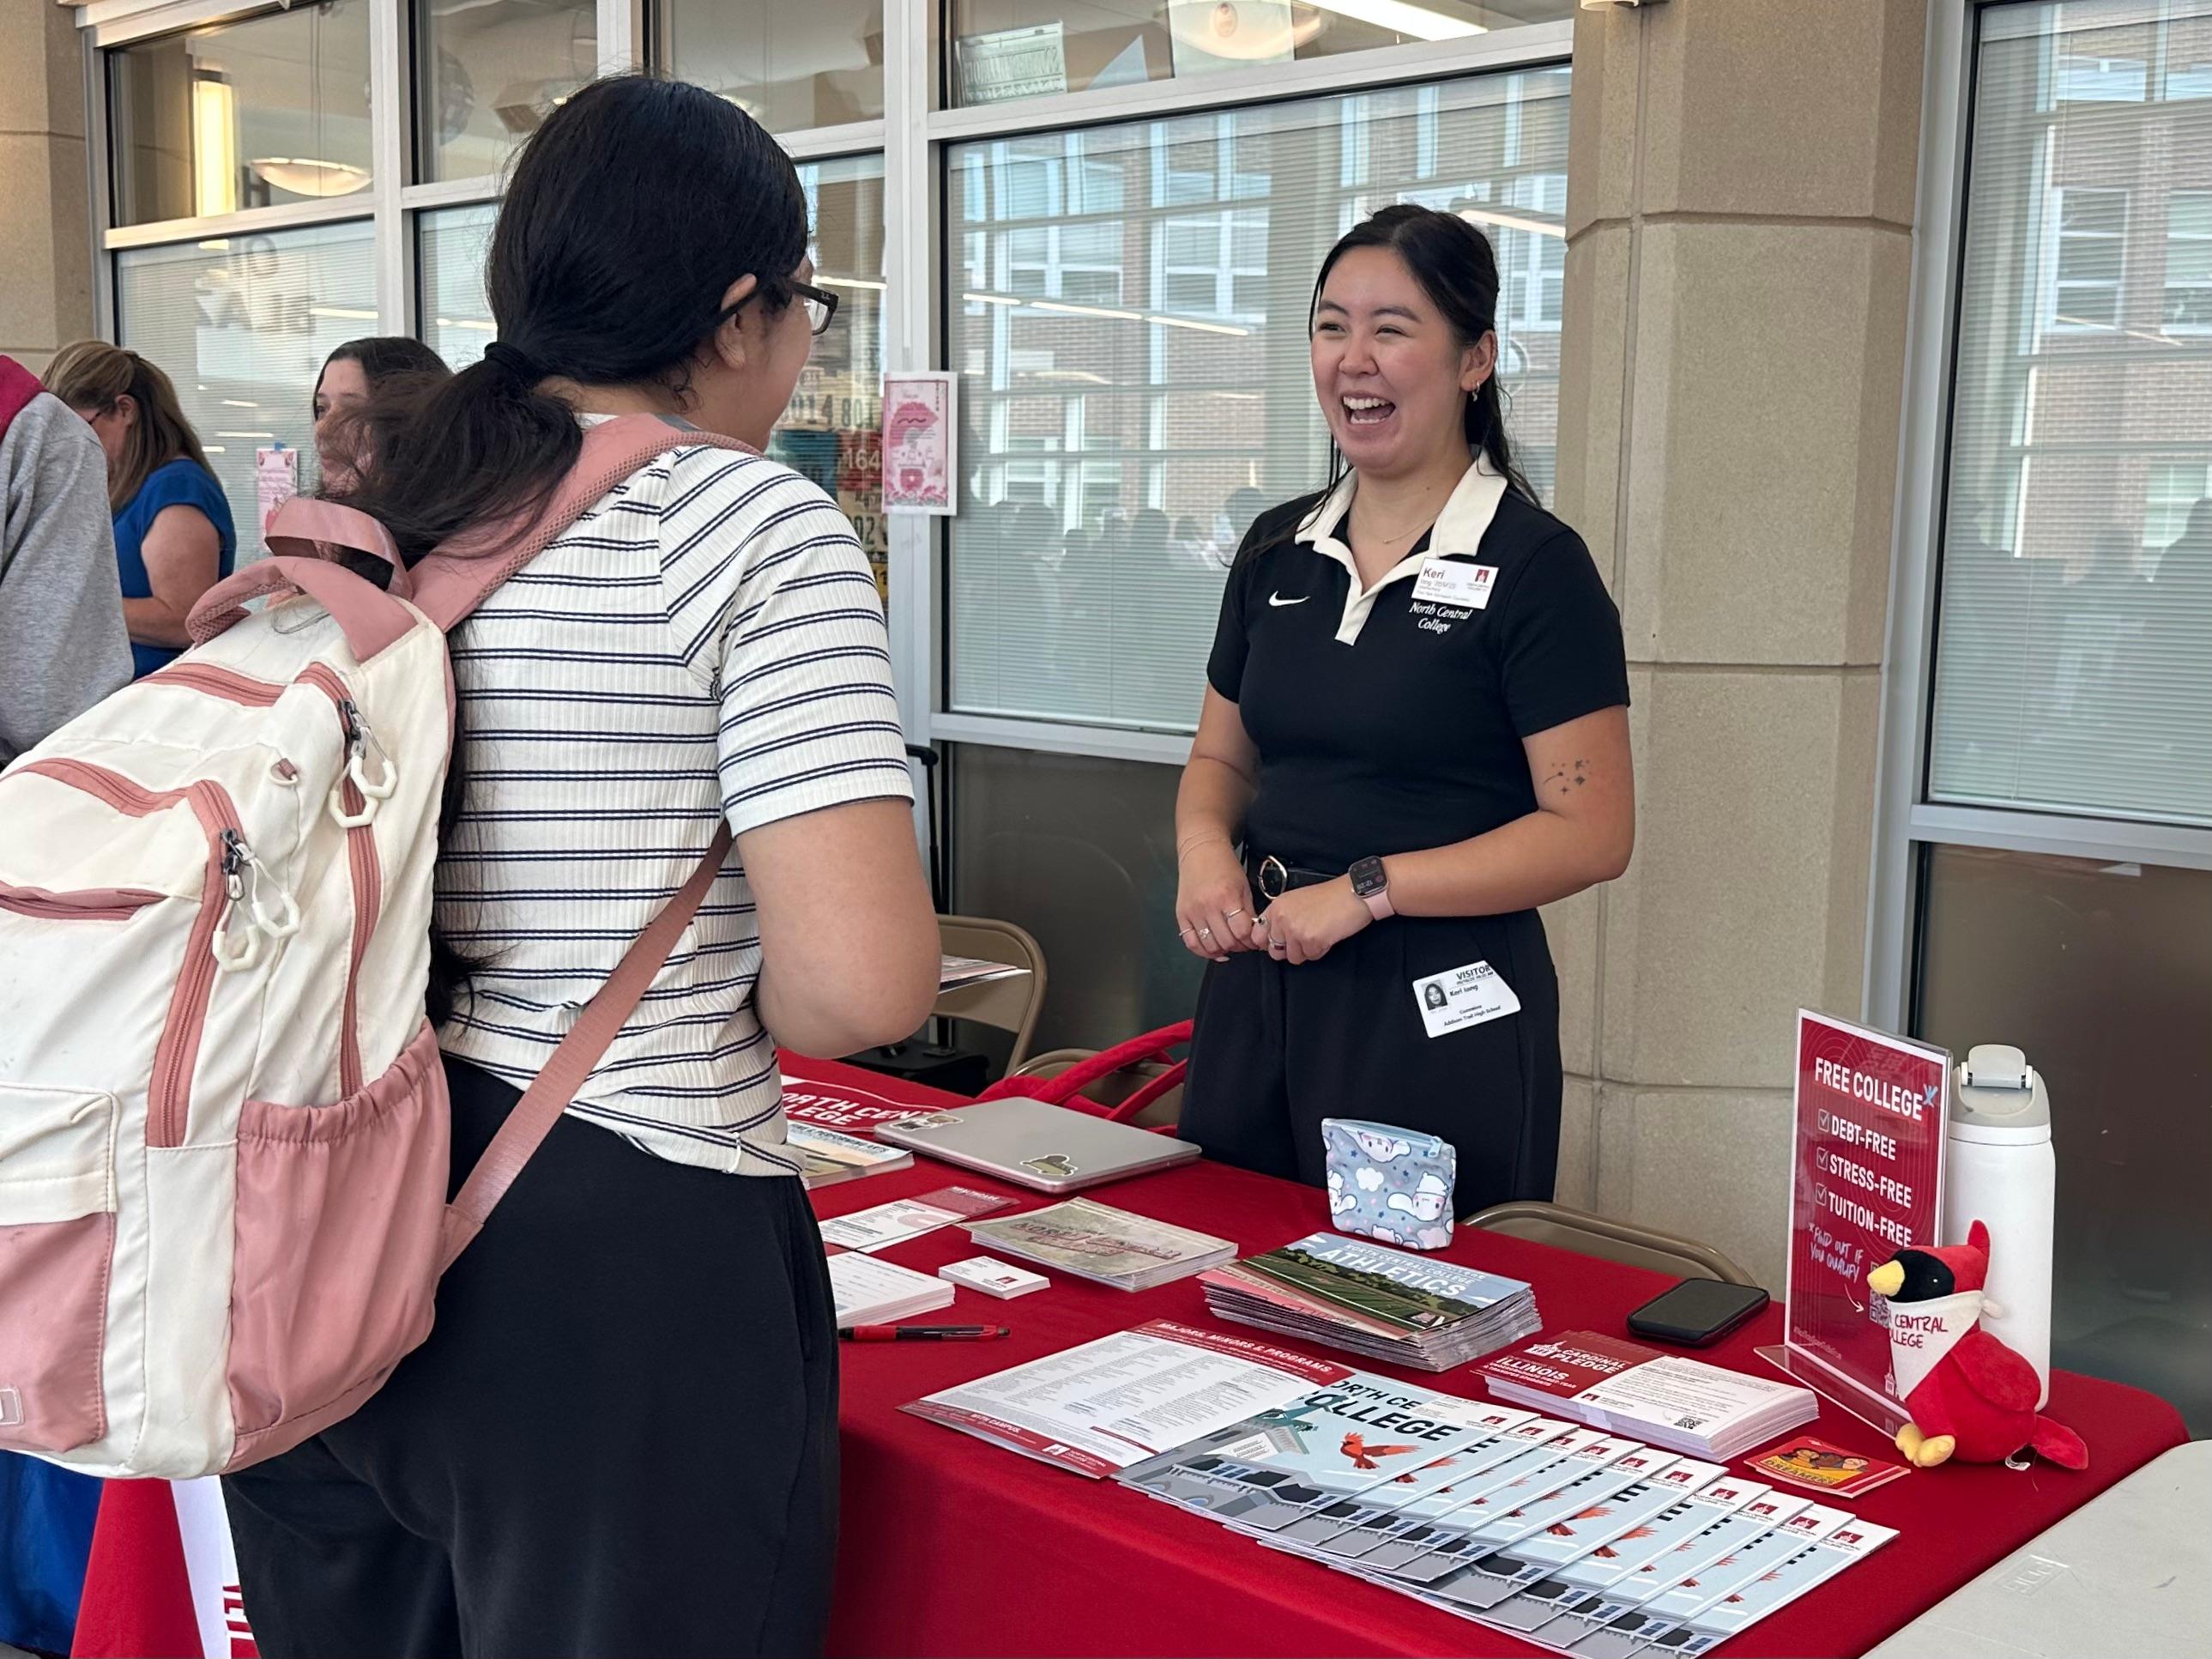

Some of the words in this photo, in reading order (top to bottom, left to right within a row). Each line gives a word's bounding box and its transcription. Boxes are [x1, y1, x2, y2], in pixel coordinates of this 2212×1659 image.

[1423, 567, 1446, 579] Keri
[1409, 602, 1436, 615] North
[1437, 606, 1473, 620] Central
[1417, 618, 1451, 634] College
[1456, 965, 1491, 980] VISITOR
[1815, 1057, 1851, 1093] FREE
[1852, 1072, 1923, 1121] COLLEGE
[782, 1093, 861, 1112] ORTH
[783, 1105, 862, 1125] LEGE
[1831, 1115, 1896, 1161] DEBT-FREE
[1829, 1153, 1913, 1208] STRESS-FREE
[1828, 1191, 1913, 1248] TUITION-FREE
[1344, 1244, 1379, 1256] NORTH
[1378, 1254, 1423, 1270] CENTRAL
[1423, 1267, 1476, 1286] COLLEGE
[1854, 1250, 1864, 1264] IF
[1316, 1248, 1468, 1297] ATHLETICS
[1895, 1314, 1949, 1334] CENTRAL
[1891, 1329, 1924, 1349] LLEGE
[1207, 1333, 1256, 1350] MINORS
[1254, 1343, 1266, 1352] &
[1263, 1347, 1333, 1373] PROGRAMS
[1562, 1349, 1626, 1369] CARDINAL
[1496, 1356, 1570, 1380] ILLINOIS
[1549, 1353, 1621, 1374] PLEDGE
[1331, 1381, 1388, 1401] ORTH
[1386, 1396, 1422, 1410] CE
